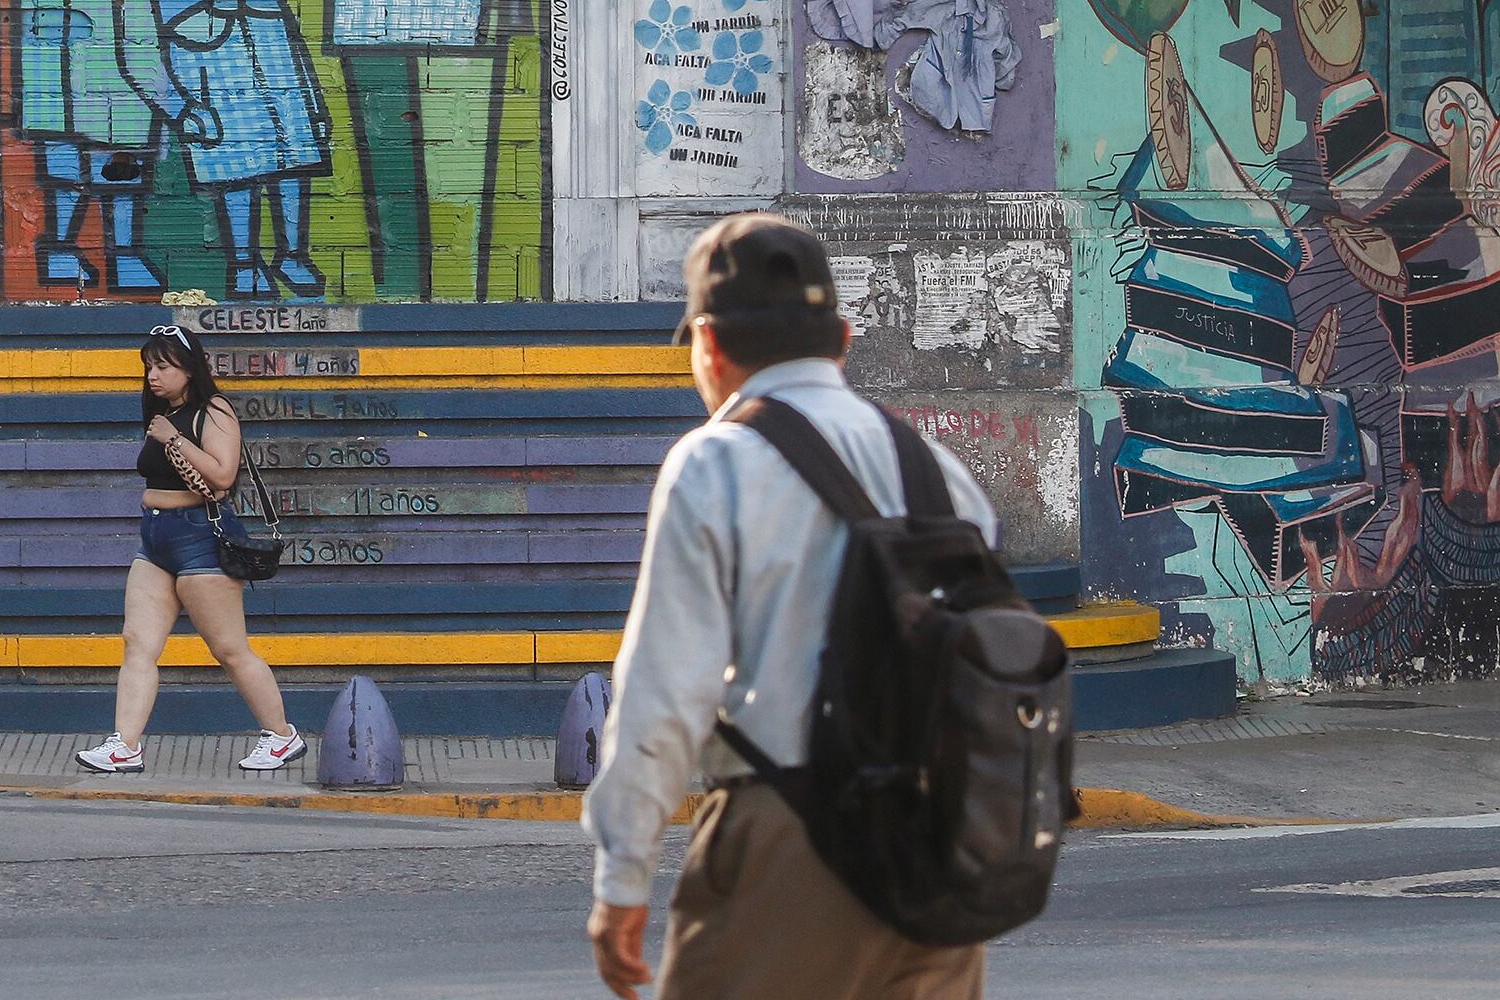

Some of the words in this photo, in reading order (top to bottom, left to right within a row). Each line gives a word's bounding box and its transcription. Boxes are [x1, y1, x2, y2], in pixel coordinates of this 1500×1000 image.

[706, 127, 742, 143] FALTA
[922, 275, 946, 286] Fuera
[949, 275, 957, 286] el
[960, 275, 976, 286] FMI
[199, 308, 290, 331] CELESTE
[295, 353, 309, 374] 4
[317, 357, 357, 374] años
[304, 443, 321, 467] 6
[329, 446, 391, 467] años
[348, 488, 372, 514] 11
[380, 489, 440, 513] años
[284, 539, 315, 563] 13
[318, 541, 384, 563] años
